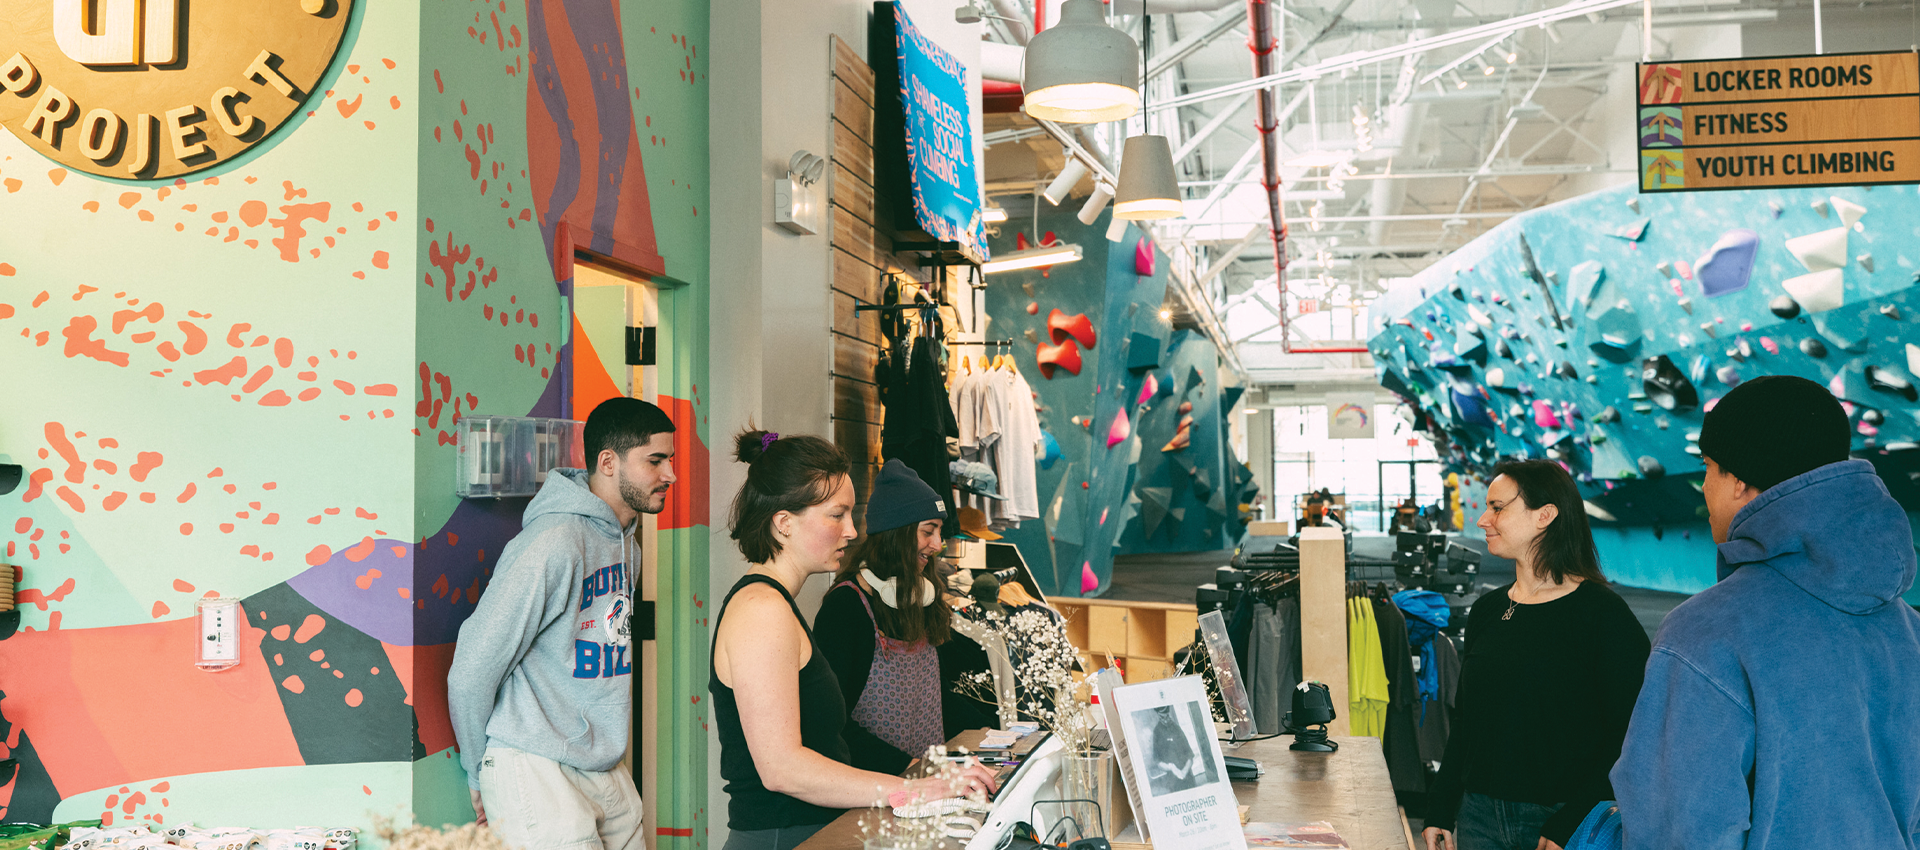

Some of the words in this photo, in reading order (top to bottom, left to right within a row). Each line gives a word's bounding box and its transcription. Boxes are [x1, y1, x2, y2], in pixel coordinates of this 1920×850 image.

[1693, 69, 1782, 92] LOCKER
[1789, 64, 1873, 89] ROOMS
[0, 49, 299, 176] PROJECT
[911, 74, 964, 138] SHAMELESS
[1694, 111, 1788, 135] FITNESS
[933, 121, 968, 167] SOCIAL
[919, 136, 960, 189] CLIMBING
[1696, 155, 1775, 178] YOUTH
[1782, 150, 1895, 175] CLIMBING
[1299, 300, 1317, 314] EXIT
[579, 562, 634, 613] BUFF
[581, 619, 597, 630] EST.
[572, 638, 631, 679] BIL
[1164, 795, 1218, 817] PHOTOGRAPHER
[1182, 814, 1194, 827] ON
[1194, 810, 1208, 824] SITE
